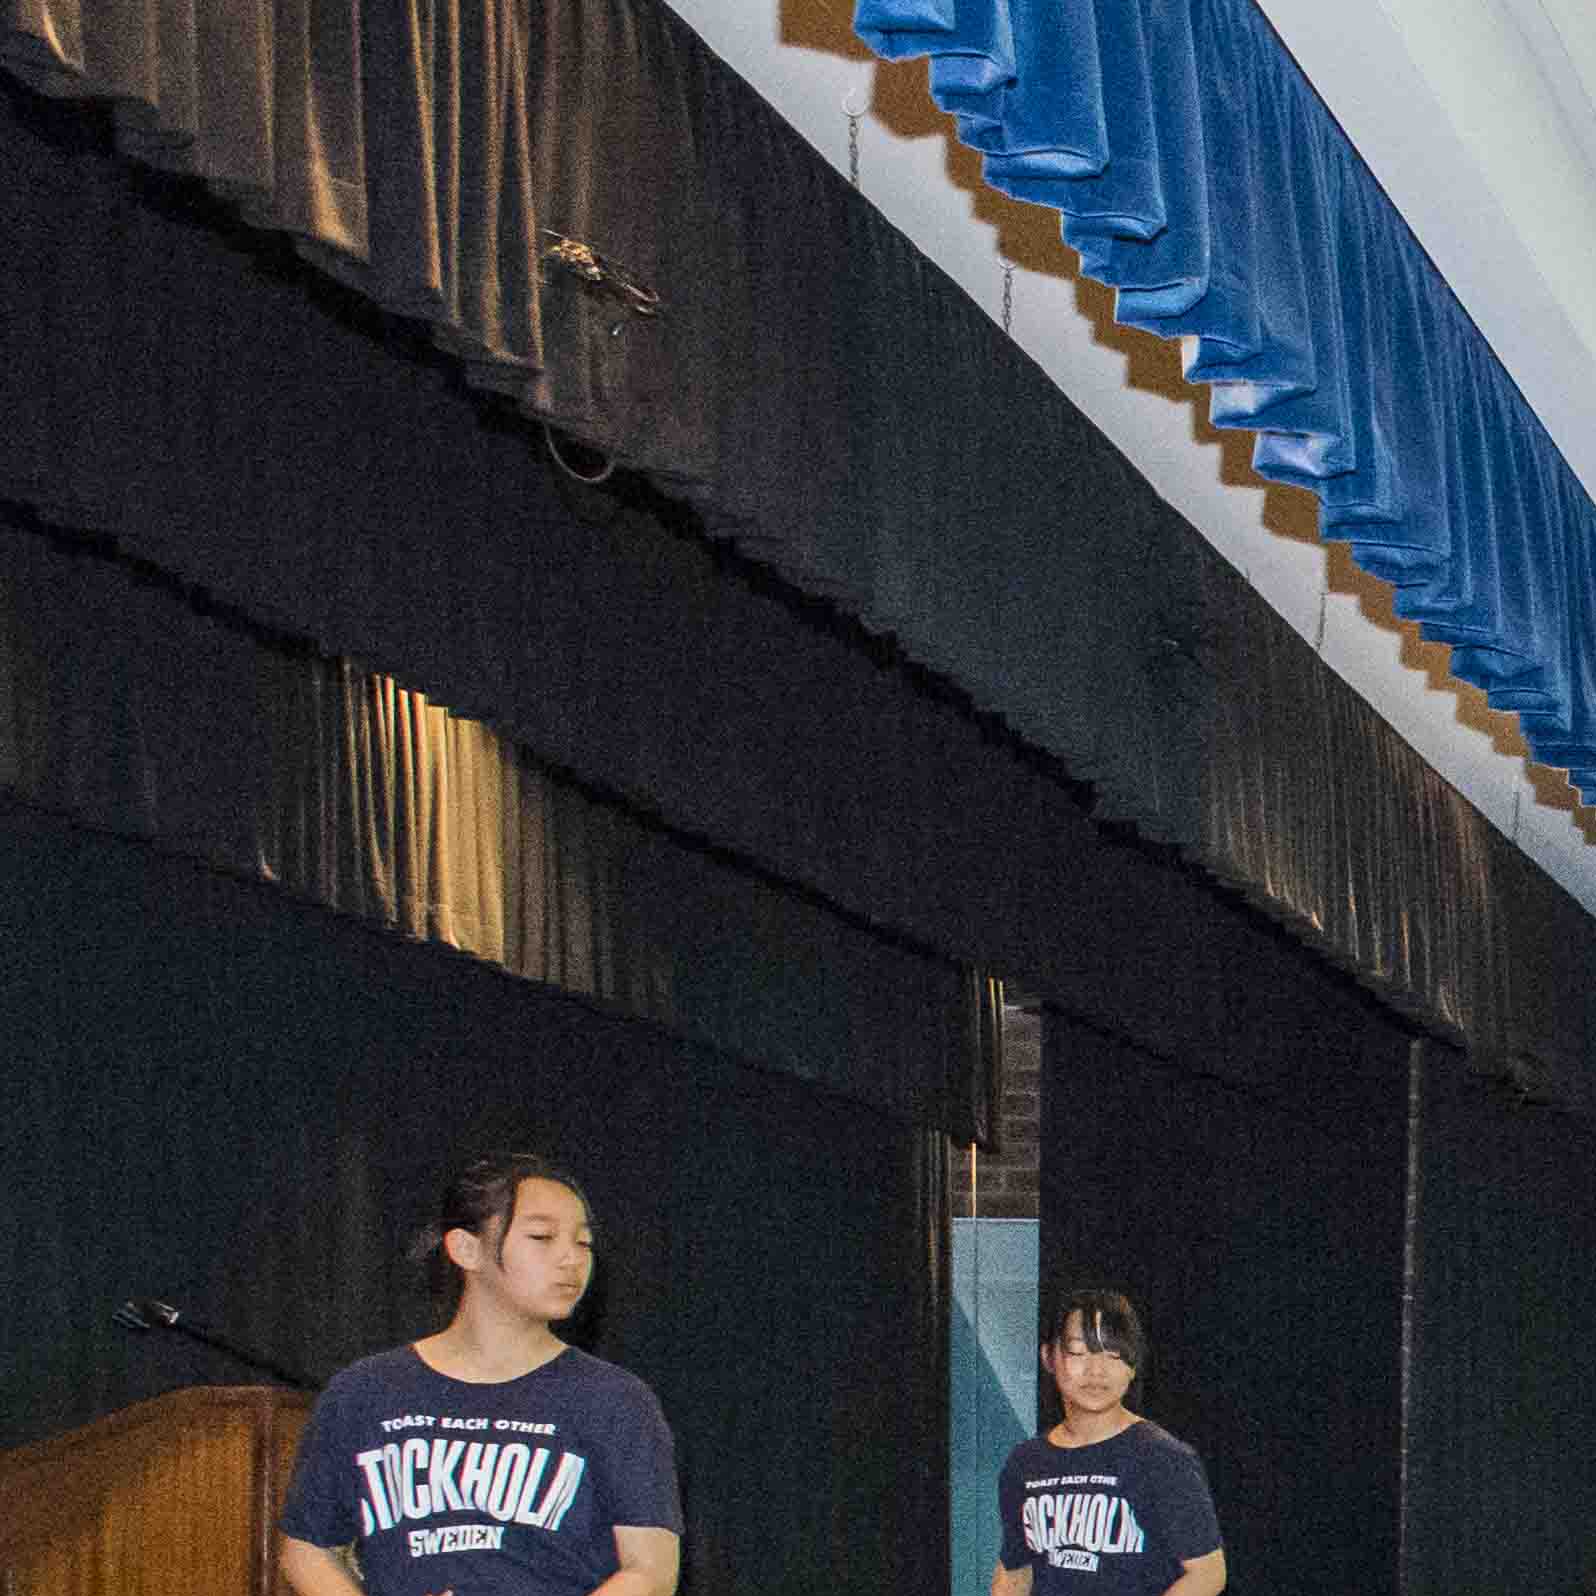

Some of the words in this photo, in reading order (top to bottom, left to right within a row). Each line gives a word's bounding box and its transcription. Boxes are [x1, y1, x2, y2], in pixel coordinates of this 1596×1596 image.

[380, 1415, 435, 1432] TOAST
[441, 1417, 488, 1430] EACH
[494, 1419, 558, 1435] OTHER
[408, 1524, 505, 1557] SWEDEN
